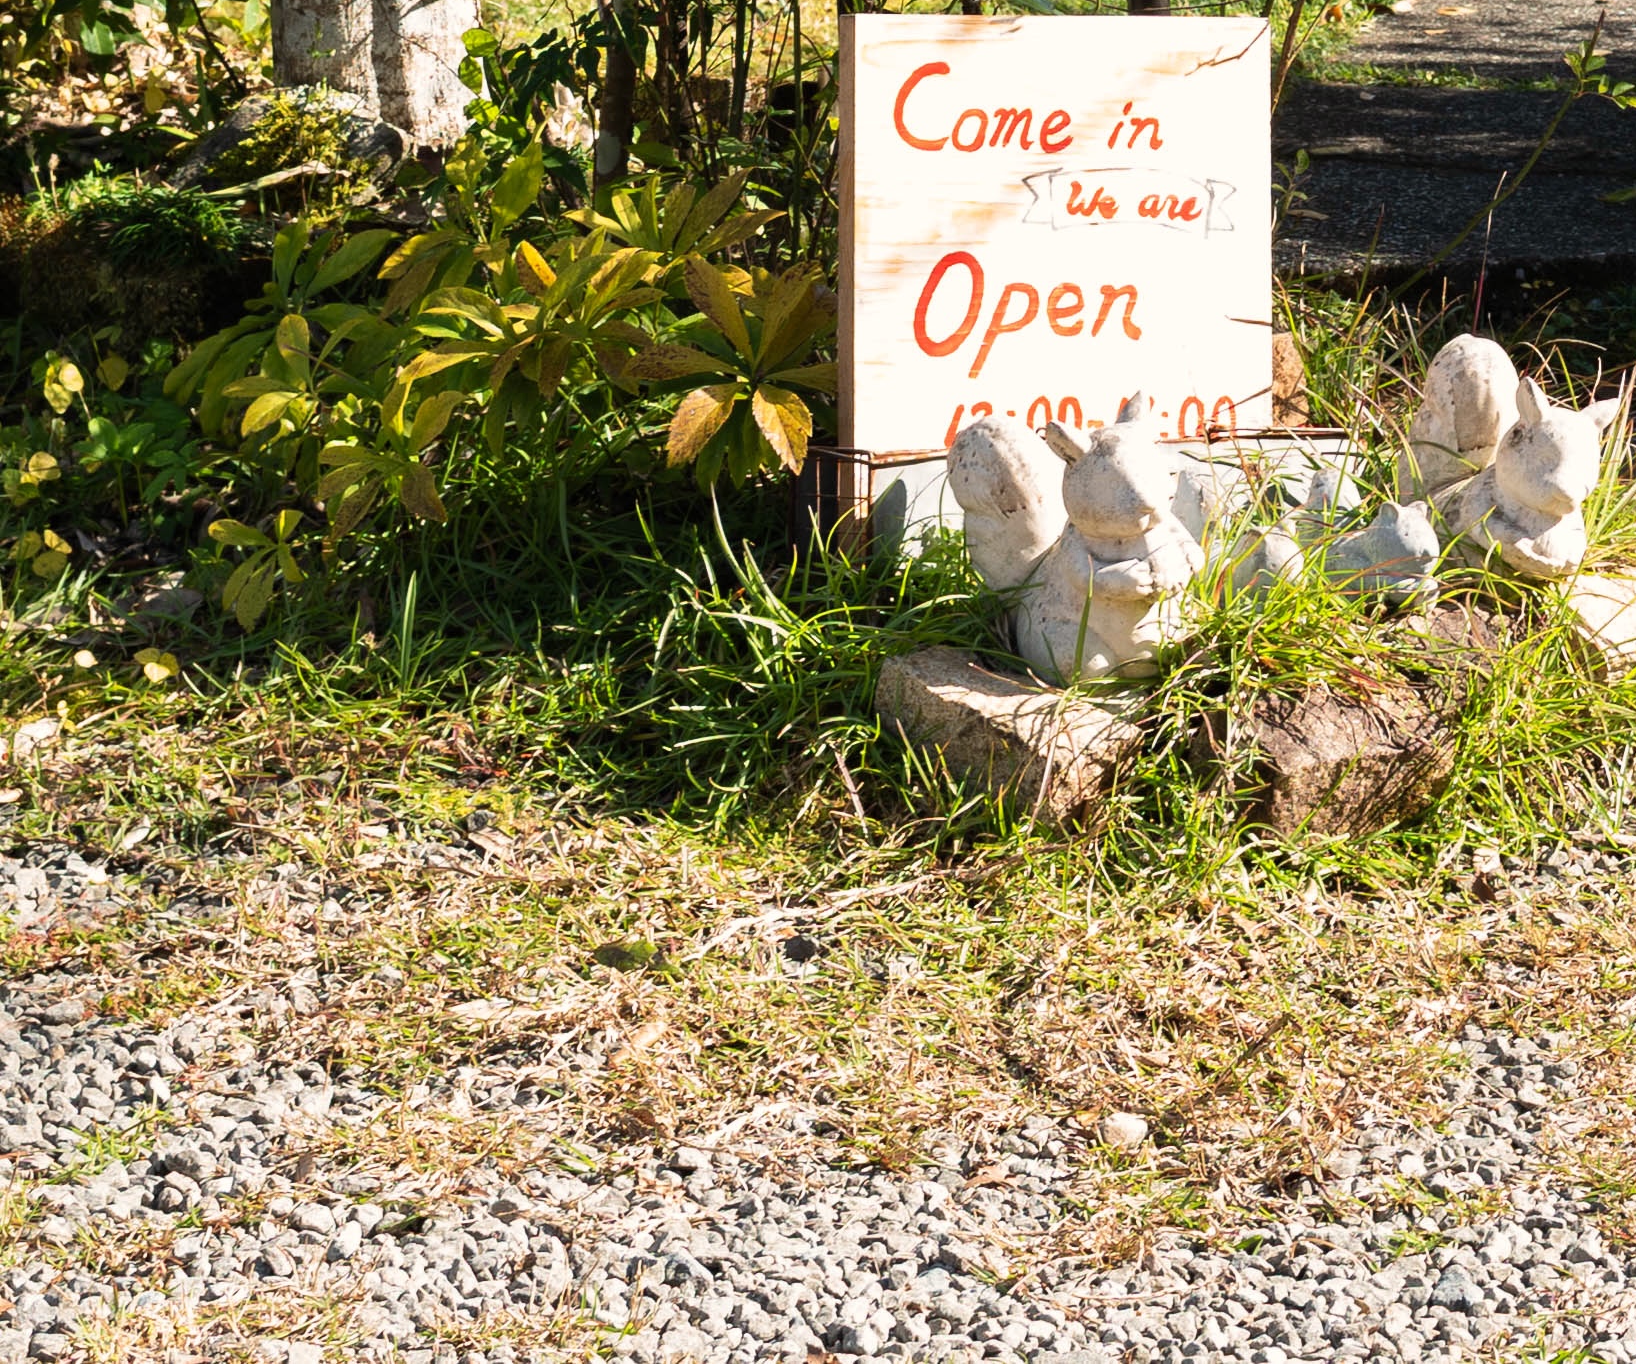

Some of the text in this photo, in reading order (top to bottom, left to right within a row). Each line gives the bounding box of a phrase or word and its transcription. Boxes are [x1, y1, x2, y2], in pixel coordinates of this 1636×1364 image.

[893, 61, 1164, 154] Come in
[1066, 181, 1202, 222] We are
[913, 250, 1143, 380] Open
